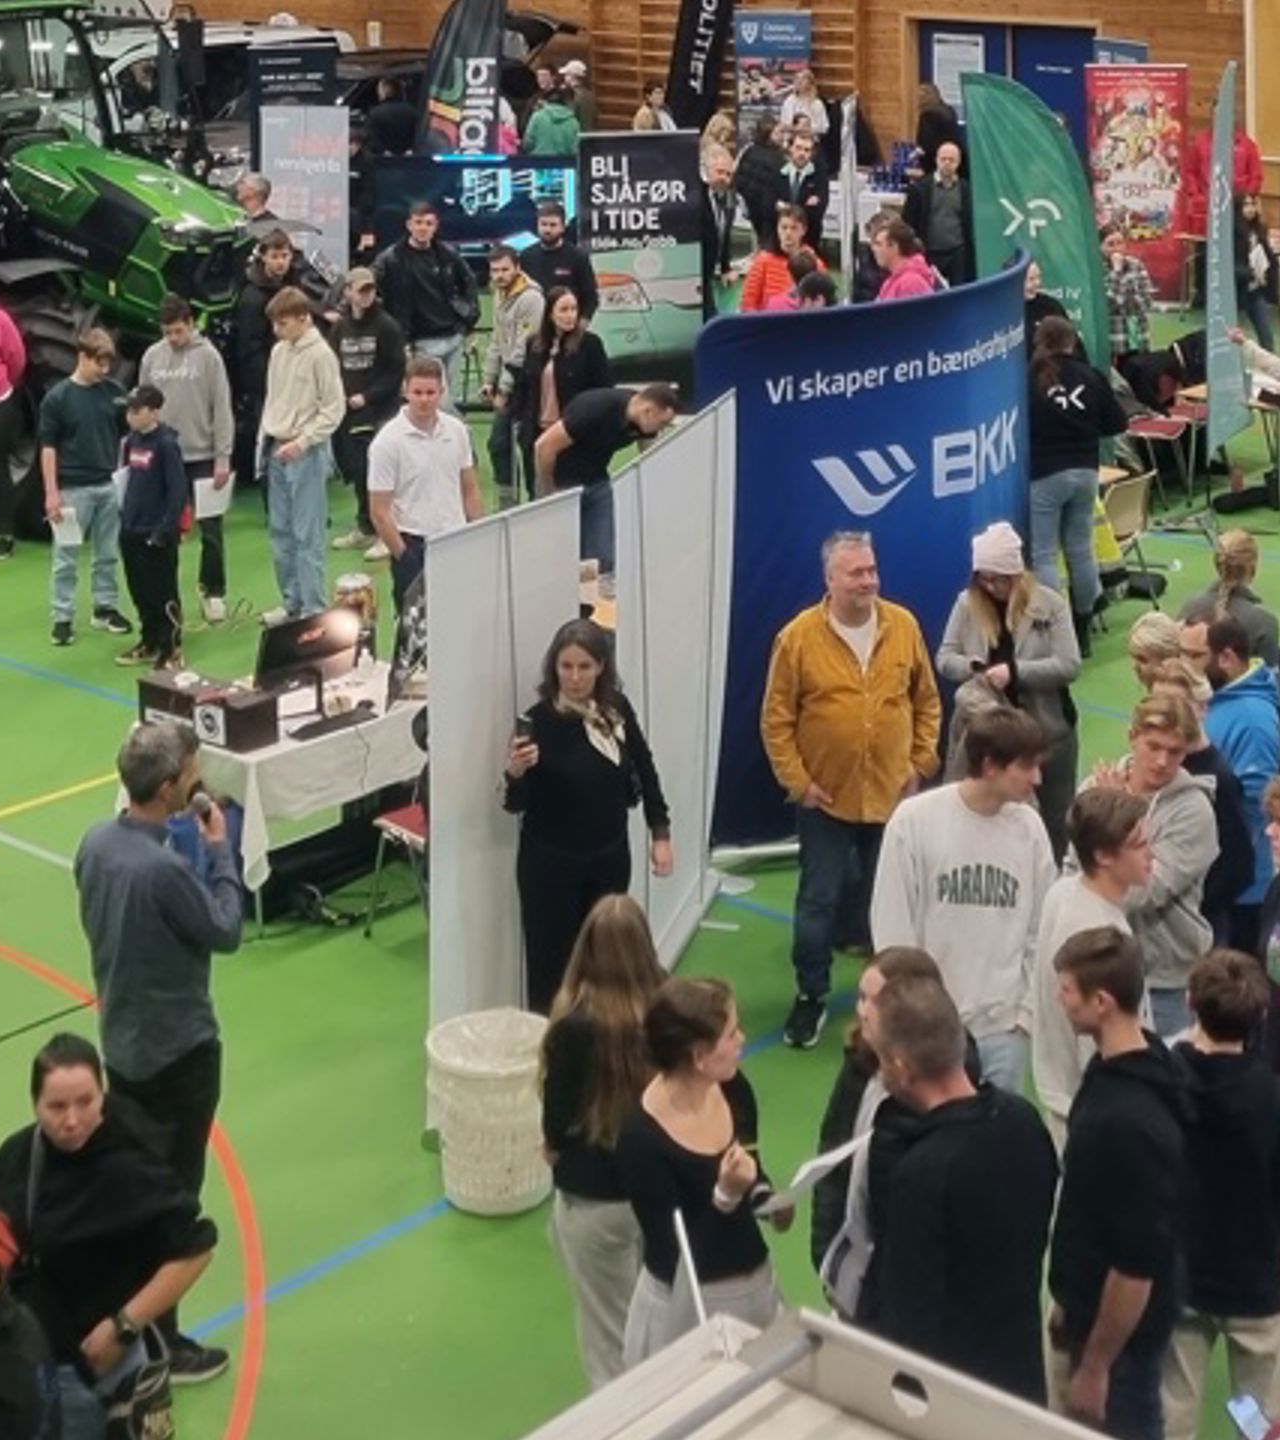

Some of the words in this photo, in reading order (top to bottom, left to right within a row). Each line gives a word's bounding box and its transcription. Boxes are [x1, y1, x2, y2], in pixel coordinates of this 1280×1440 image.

[460, 57, 497, 154] bilfa
[591, 155, 629, 178] BLI
[591, 176, 686, 204] SJÅFØR
[592, 208, 599, 232] I
[604, 206, 661, 230] TIDE
[766, 374, 793, 405] Vi
[799, 364, 890, 399] skaper
[894, 357, 923, 384] en
[932, 405, 1020, 499] BKK
[937, 864, 1020, 908] PARADISE
